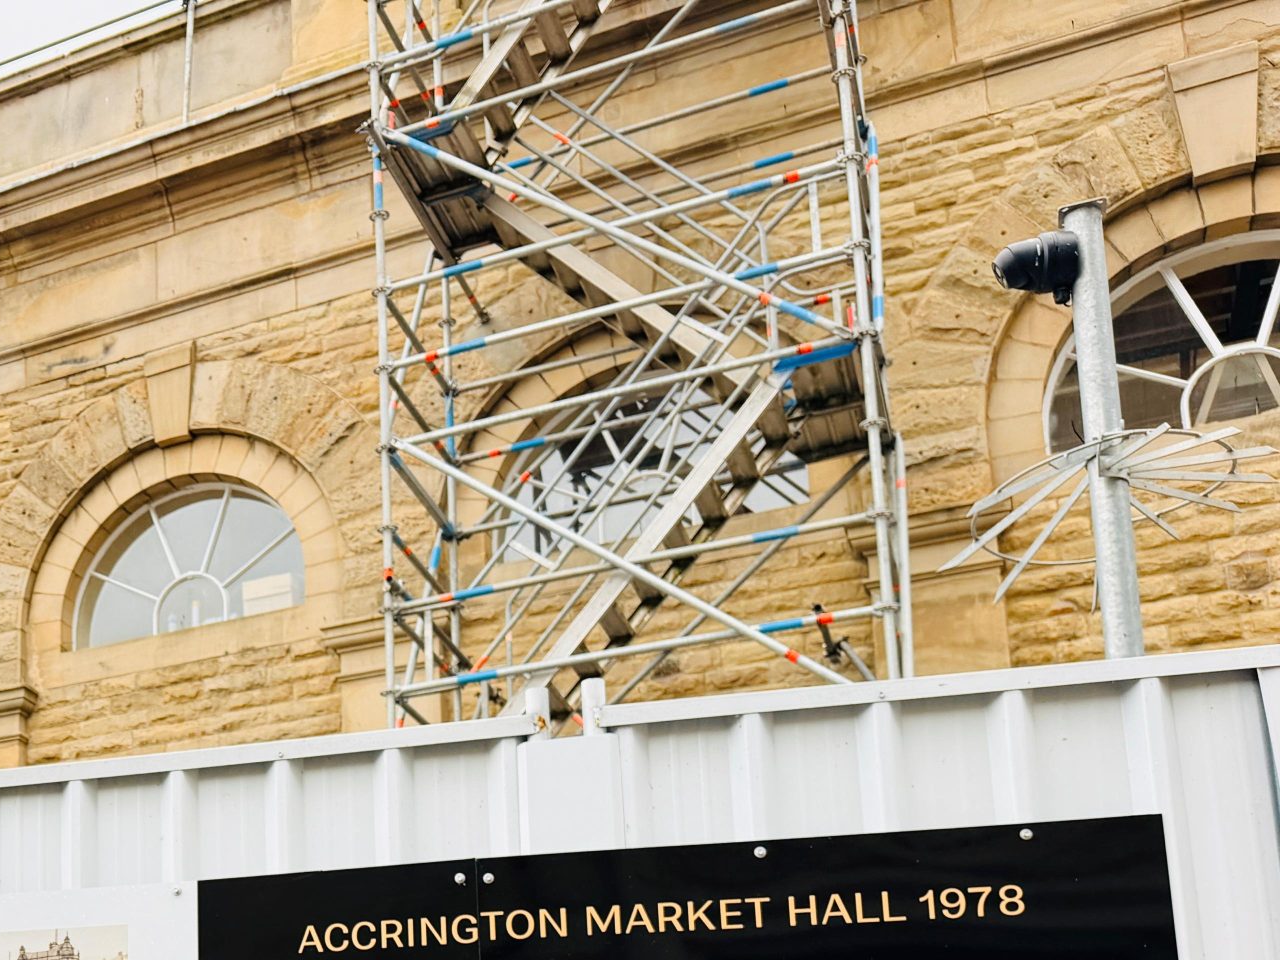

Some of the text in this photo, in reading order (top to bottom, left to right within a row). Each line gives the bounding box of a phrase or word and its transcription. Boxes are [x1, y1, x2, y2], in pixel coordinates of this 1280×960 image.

[297, 883, 1027, 954] ACCRINGTON MARKET HALL 1978
